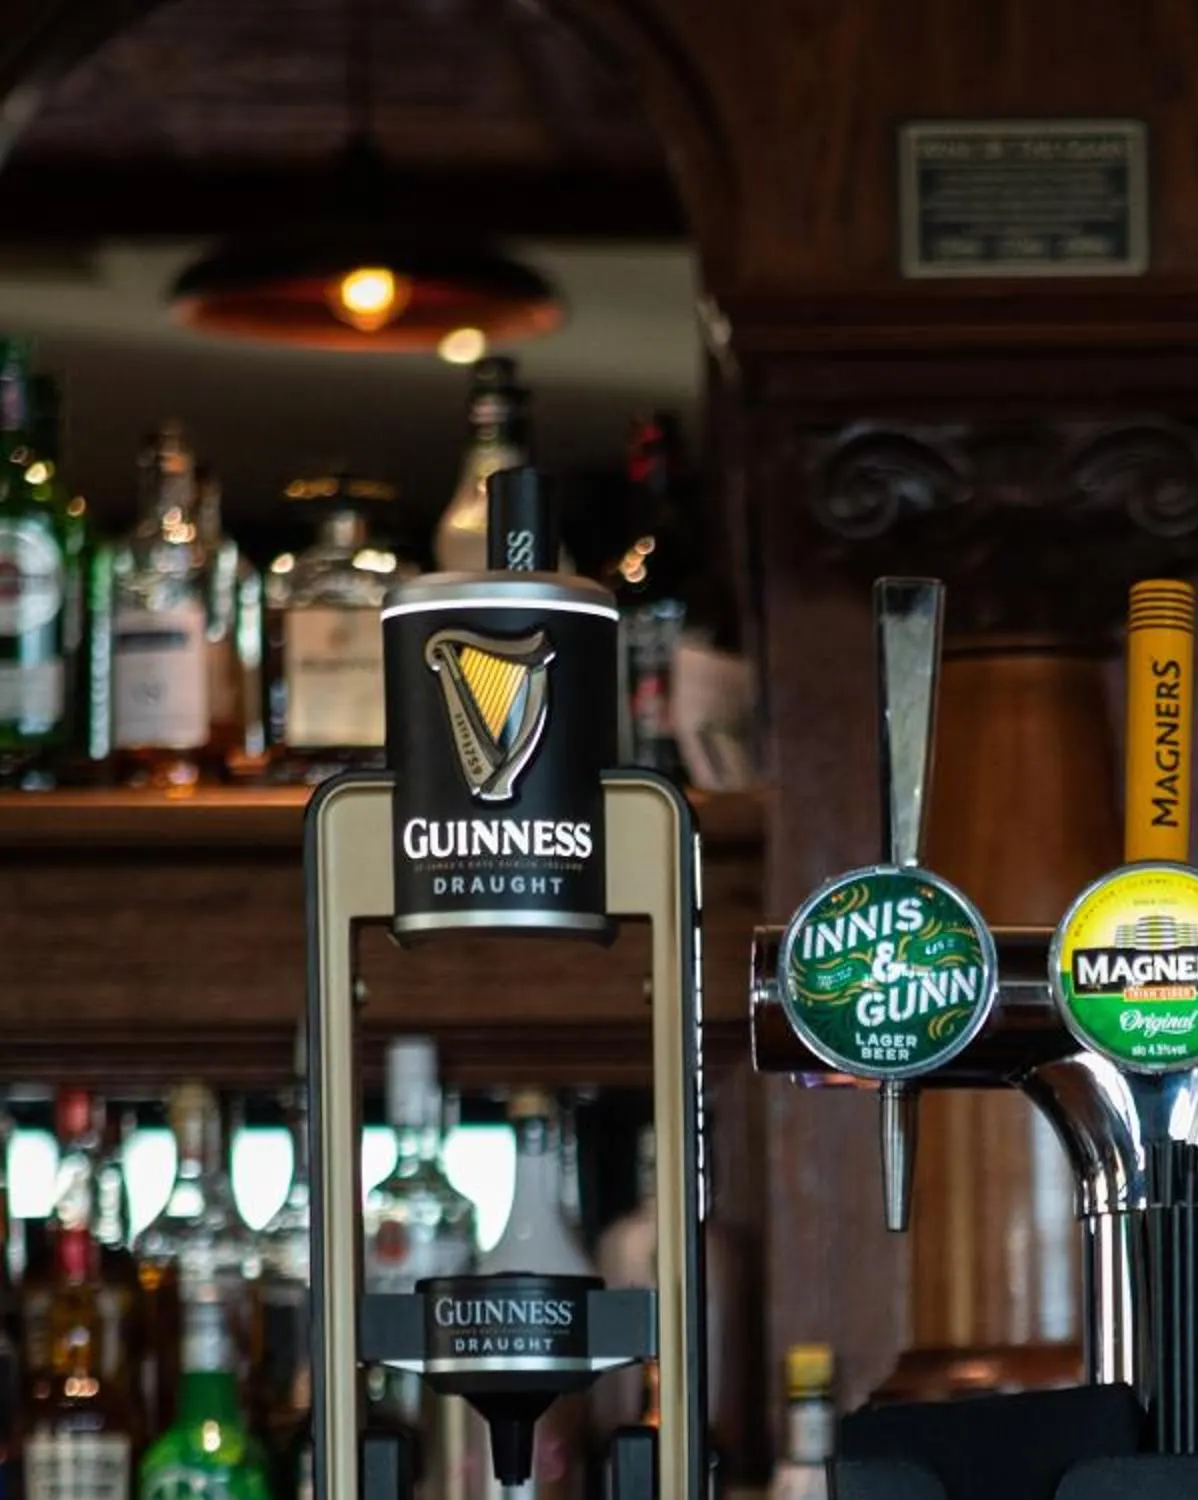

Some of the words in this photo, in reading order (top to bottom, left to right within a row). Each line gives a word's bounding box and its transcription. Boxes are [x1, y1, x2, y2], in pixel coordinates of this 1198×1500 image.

[1151, 658, 1181, 828] MAGNERS
[403, 817, 593, 859] GUINNESS
[433, 876, 563, 895] DRAUGHT
[803, 896, 924, 960] INNIS
[872, 940, 910, 984] &
[856, 966, 978, 1027] GUNN
[1119, 1009, 1198, 1039] Original
[855, 1032, 918, 1048] LAGER
[861, 1047, 910, 1061] BEER
[435, 1297, 573, 1327] GUINNESS
[455, 1338, 553, 1352] DRAUGHT
